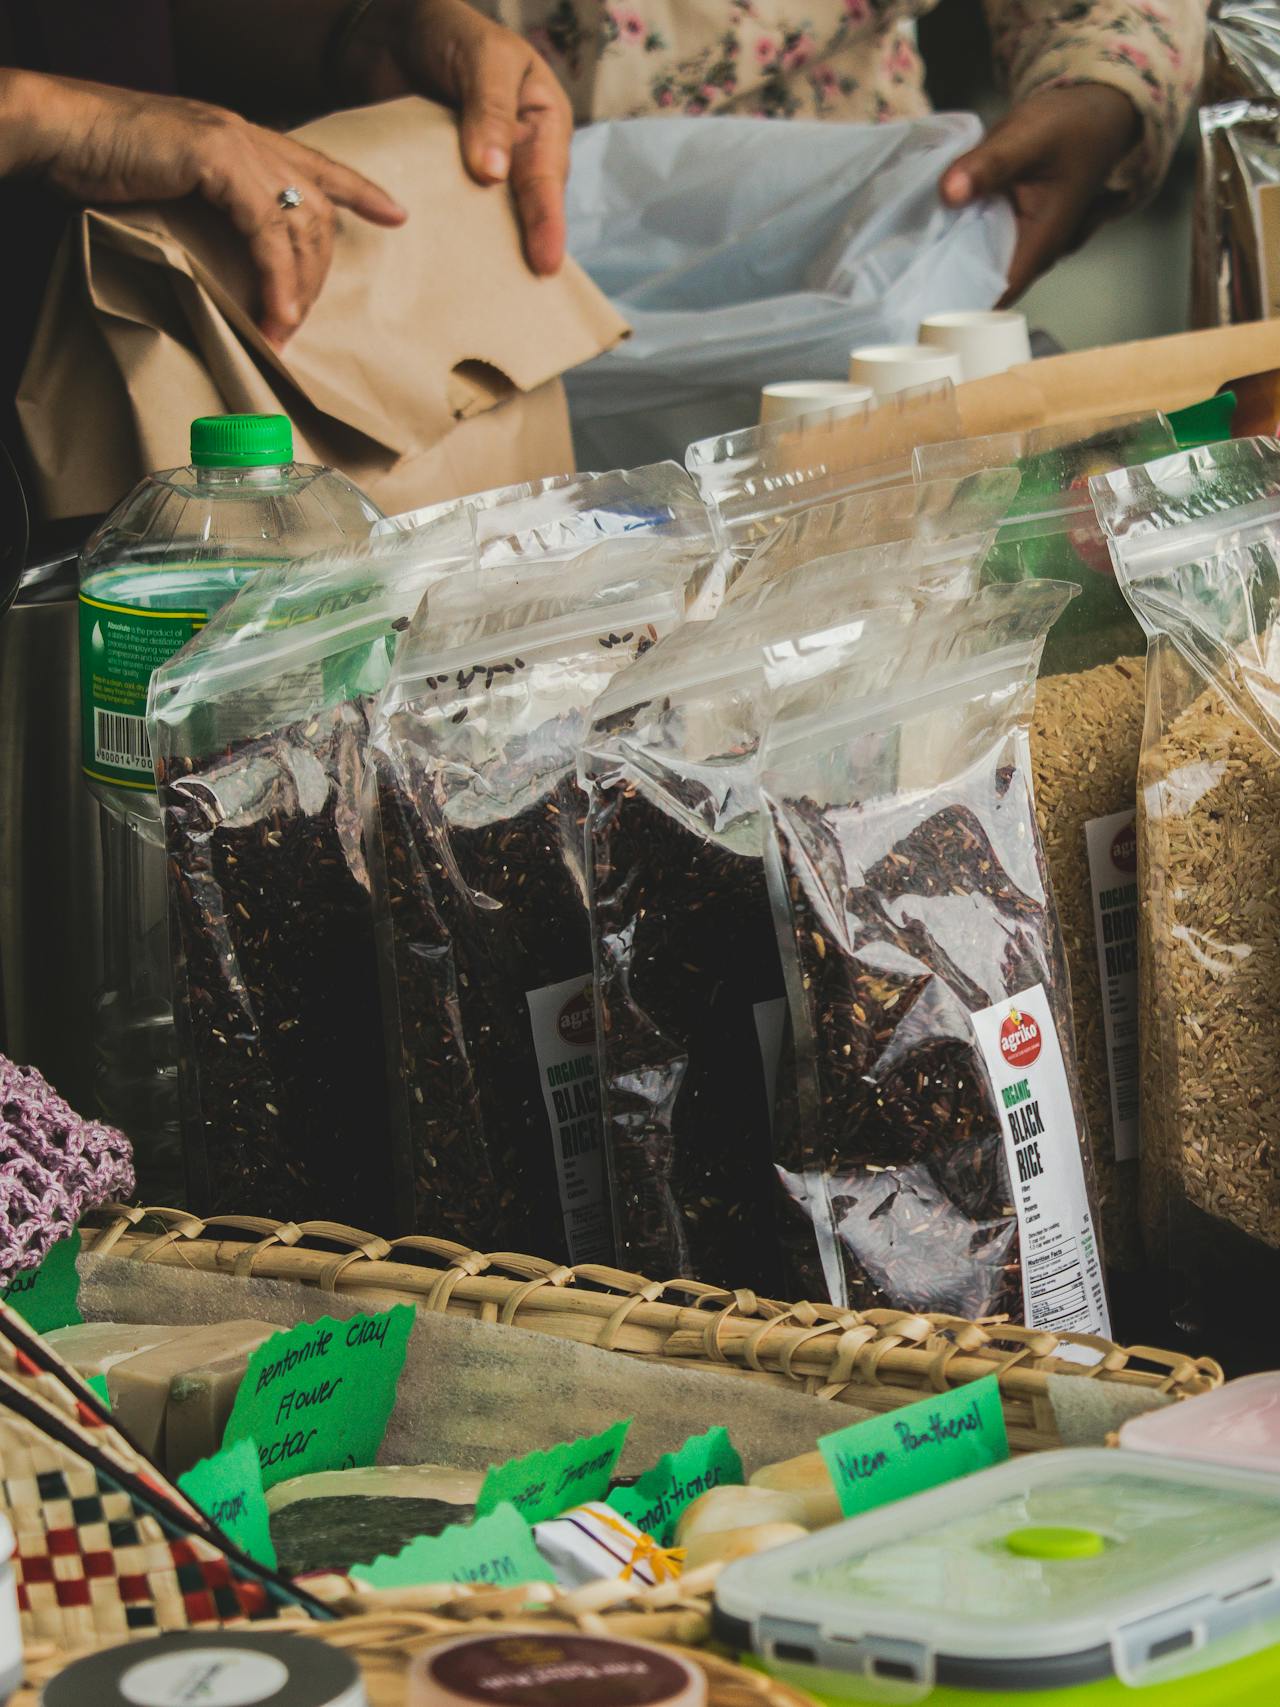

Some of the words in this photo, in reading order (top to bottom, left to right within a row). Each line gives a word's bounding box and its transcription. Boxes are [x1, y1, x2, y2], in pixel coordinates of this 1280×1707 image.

[147, 629, 173, 637] product
[1001, 1023, 1038, 1053] agriko
[1001, 1078, 1032, 1109] ORGANIC
[1008, 1101, 1046, 1146] BLACK
[1016, 1141, 1044, 1183] RICE
[1027, 1255, 1050, 1266] Nutrition
[1050, 1249, 1062, 1258] Facts
[345, 1318, 391, 1348] Clay
[275, 1377, 343, 1425] Flower
[258, 1428, 318, 1470] ectar
[838, 1449, 889, 1488] Neem
[893, 1401, 985, 1454] Panthenol
